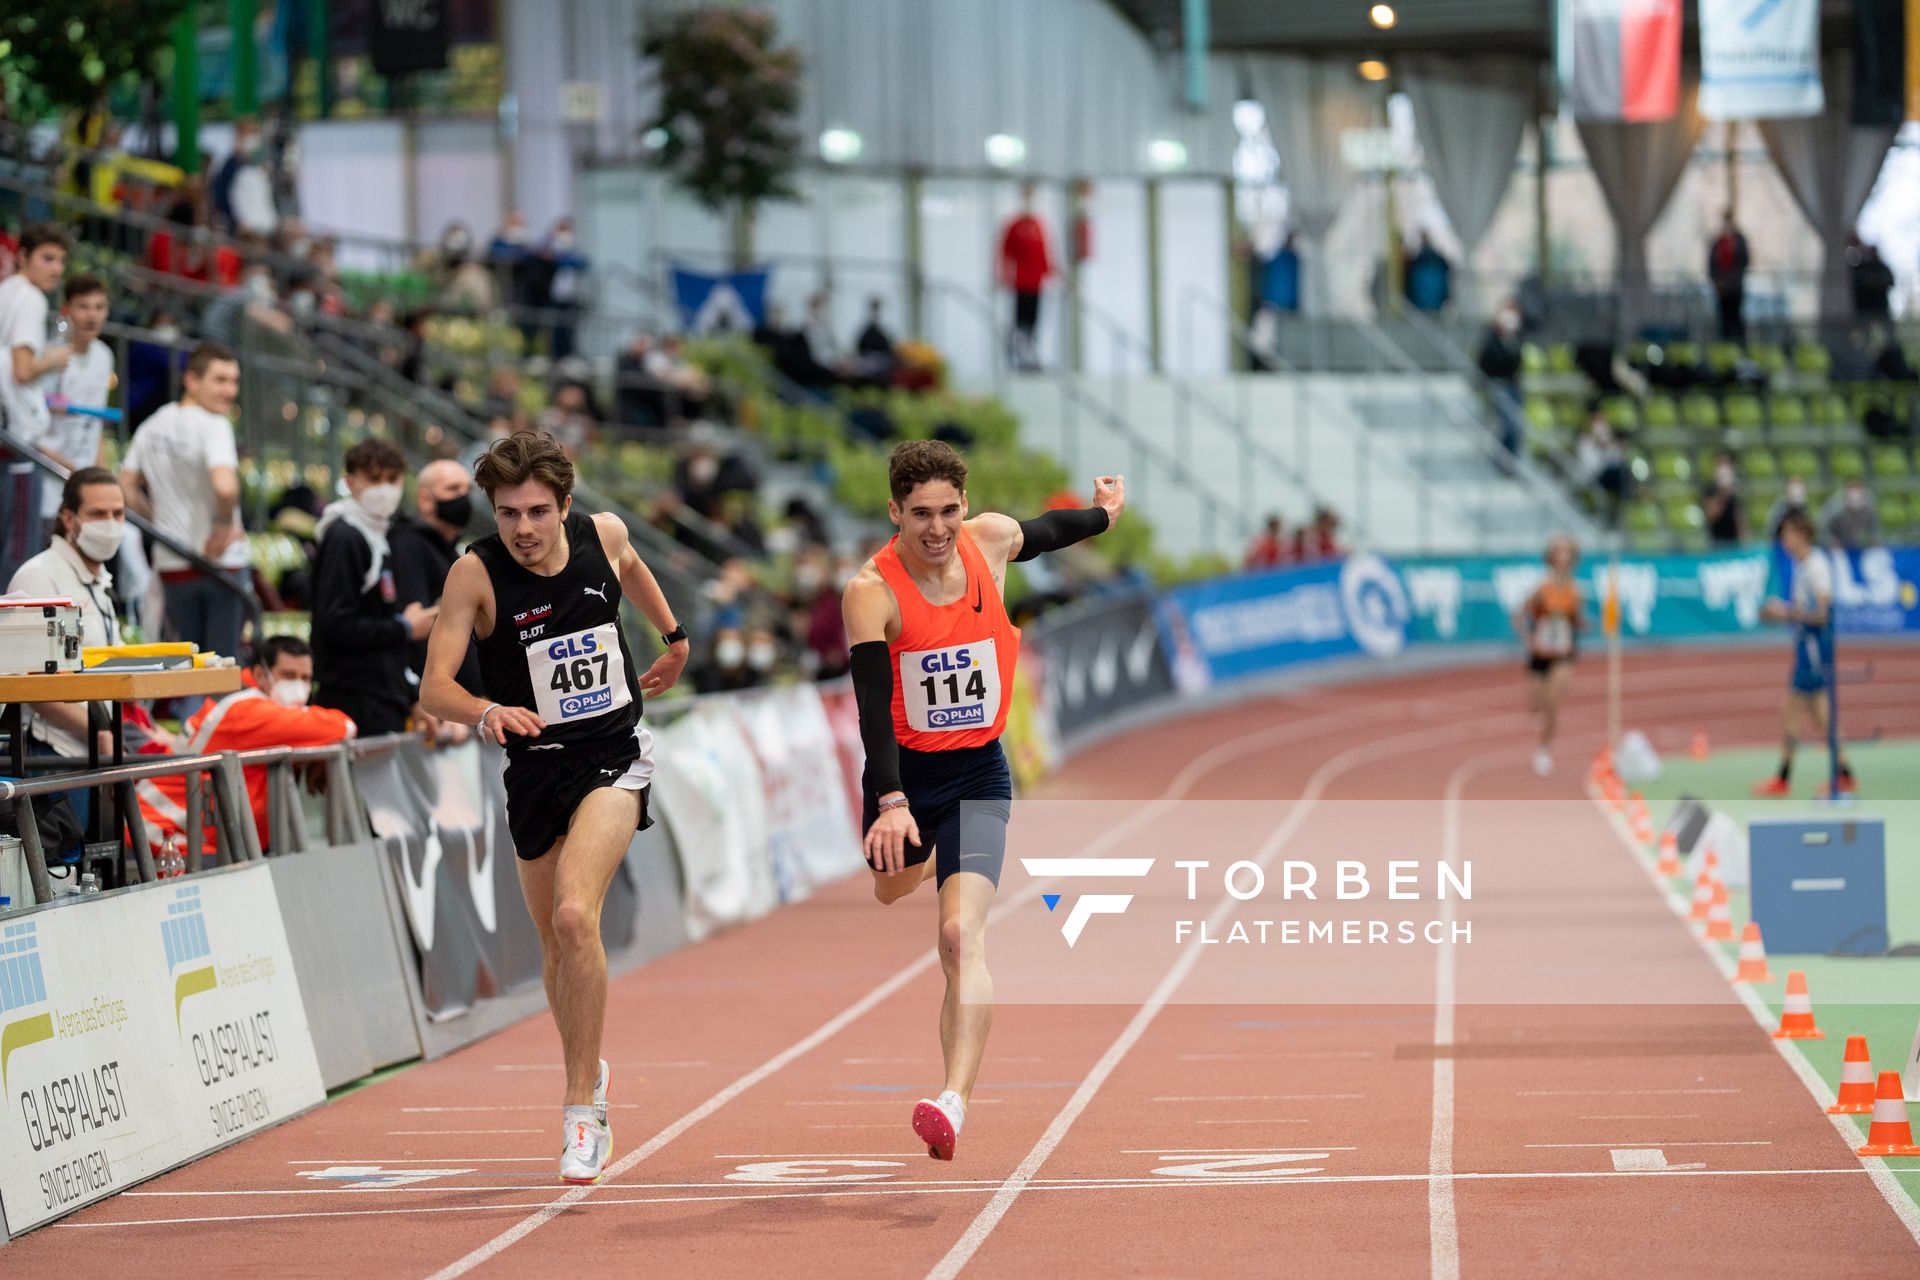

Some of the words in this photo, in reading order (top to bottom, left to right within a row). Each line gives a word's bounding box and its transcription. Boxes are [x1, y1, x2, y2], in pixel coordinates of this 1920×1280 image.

[531, 603, 552, 616] TEAM
[550, 653, 609, 694] 467
[920, 669, 987, 706] 114
[583, 691, 610, 706] PLAN
[951, 707, 981, 720] PLAN
[55, 1008, 83, 1040] Arena
[81, 1000, 98, 1032] des
[93, 994, 128, 1032] Erfolges
[192, 1010, 280, 1087] GLASPALAST
[21, 1061, 128, 1152] GLASPALAST
[209, 1086, 270, 1137] SINDELFINGEN
[39, 1148, 113, 1210] SINDELFINGEN
